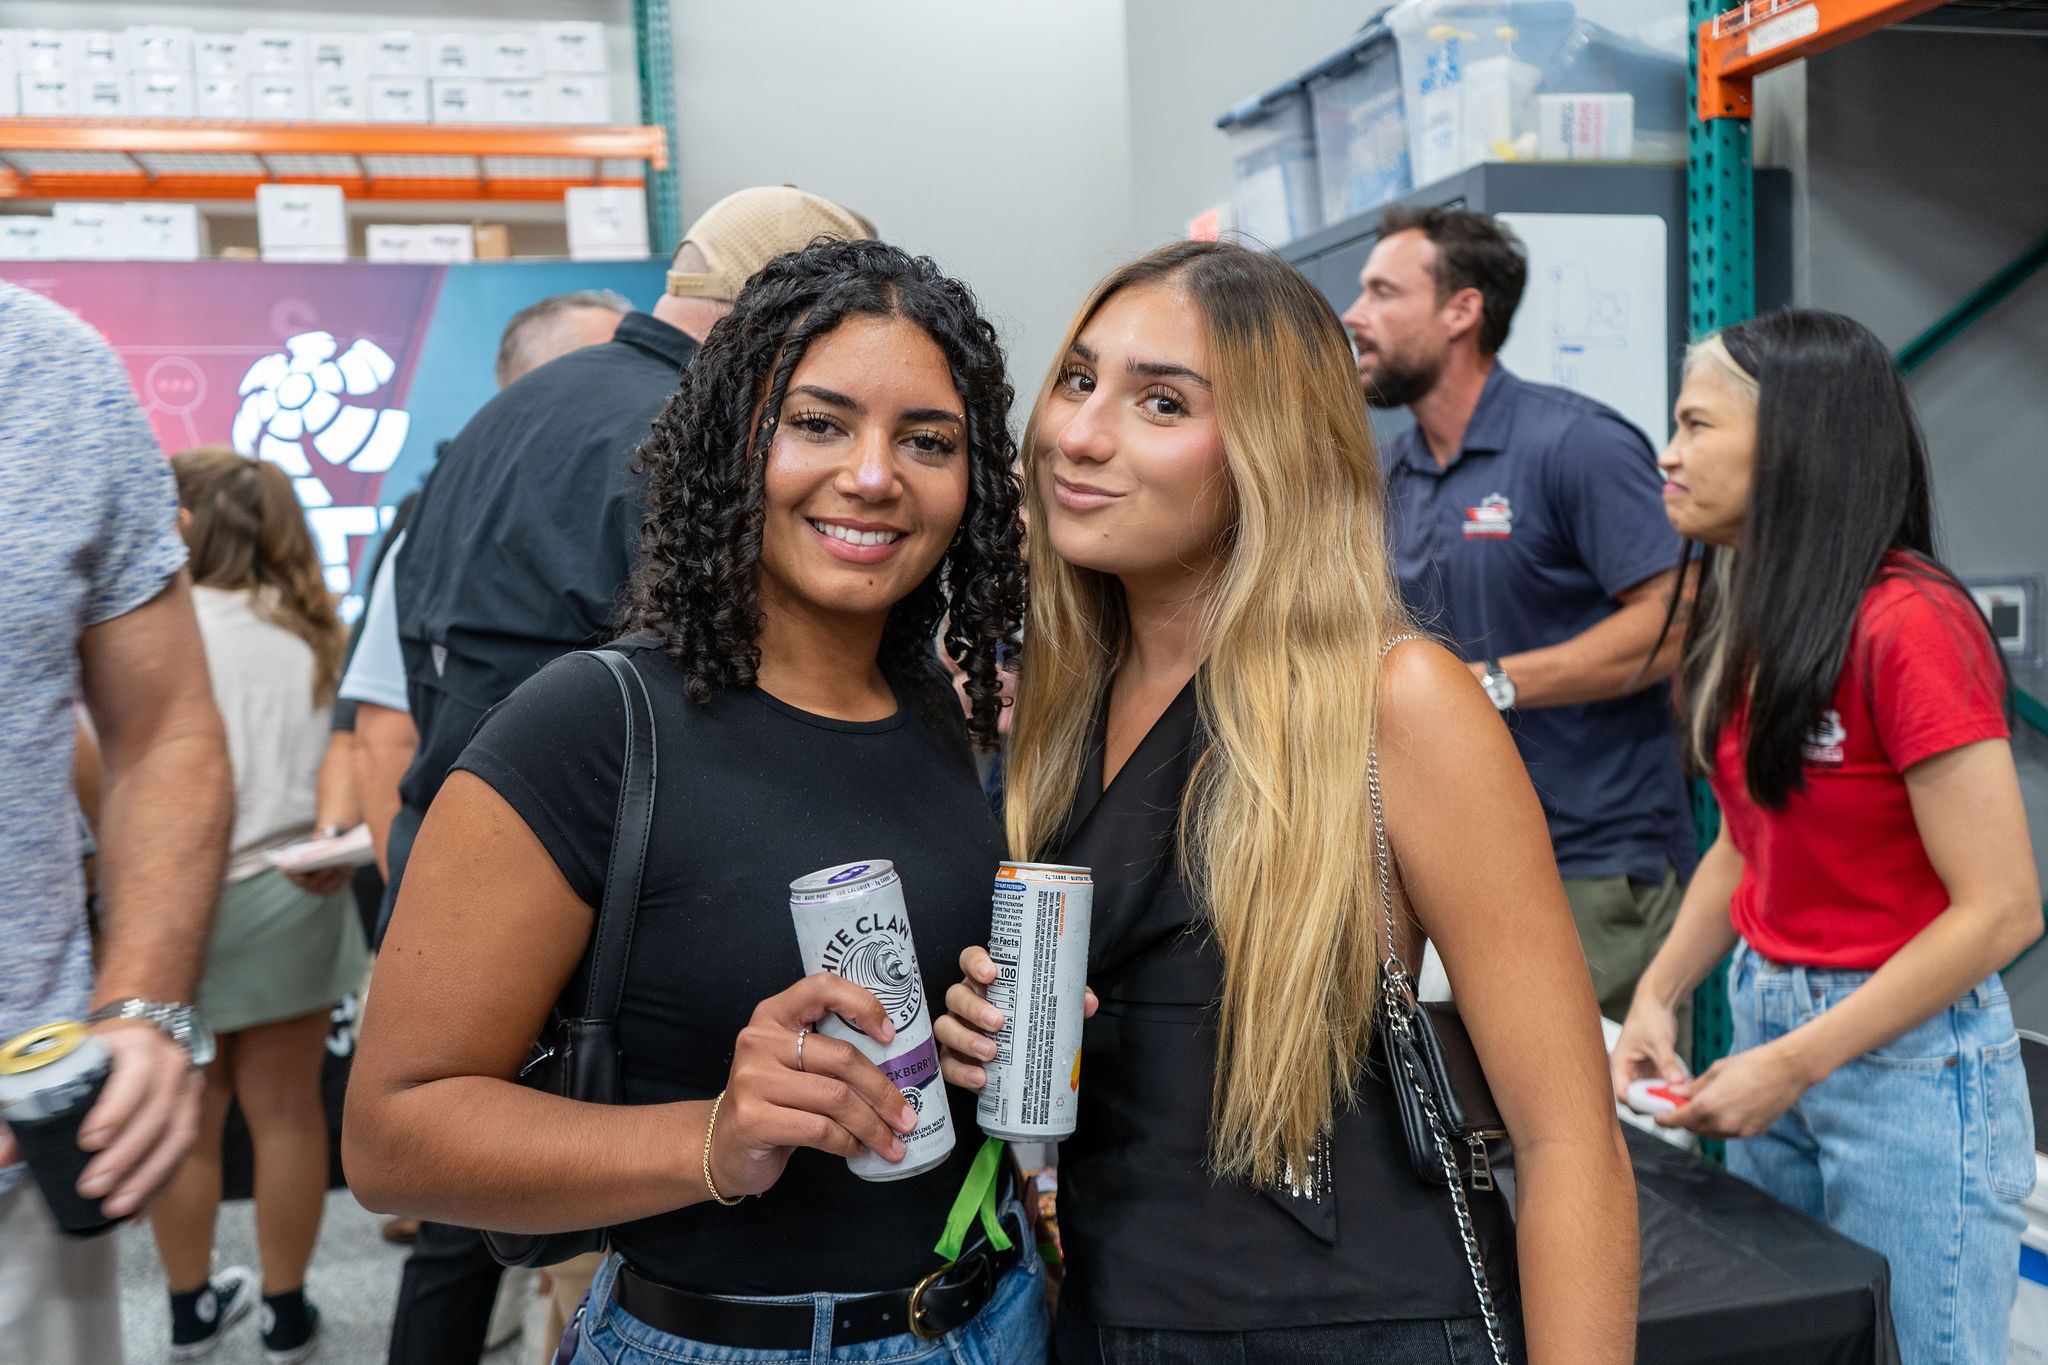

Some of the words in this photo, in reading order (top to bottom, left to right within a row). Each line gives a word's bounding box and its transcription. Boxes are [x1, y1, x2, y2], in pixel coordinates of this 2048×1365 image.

[821, 928, 855, 972] HITE
[856, 913, 909, 941] CLAW
[999, 936, 1019, 947] Facts
[1000, 967, 1016, 979] 100
[886, 1055, 933, 1081] CKBERRY
[902, 1088, 922, 1098] ALORIES
